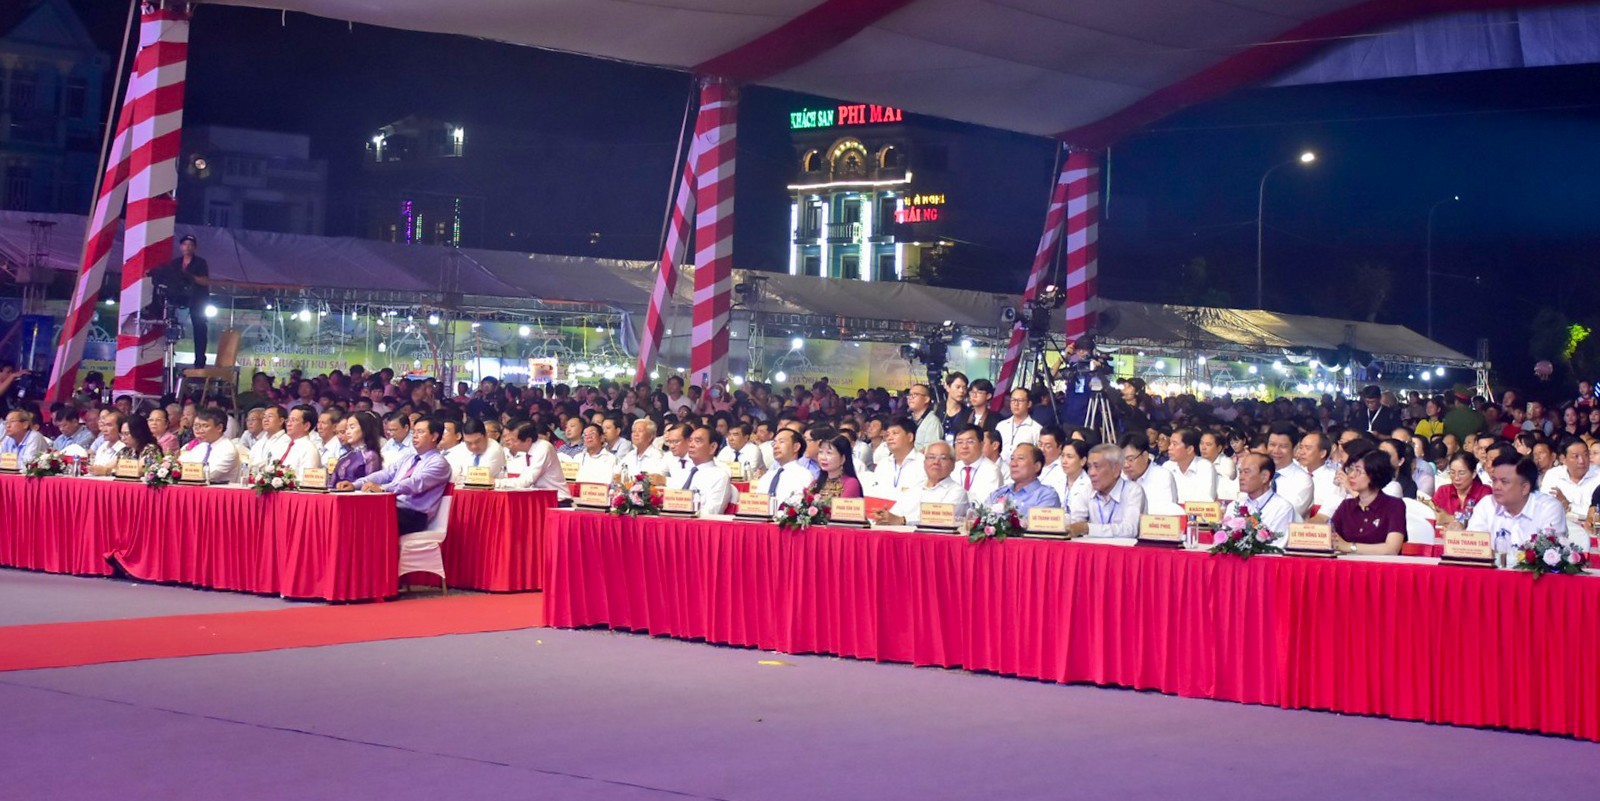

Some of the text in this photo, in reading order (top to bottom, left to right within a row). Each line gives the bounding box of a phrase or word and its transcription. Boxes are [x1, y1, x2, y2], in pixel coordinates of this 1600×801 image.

[790, 108, 816, 128] KHÁCH
[838, 104, 866, 126] PHI
[869, 104, 902, 123] MAI
